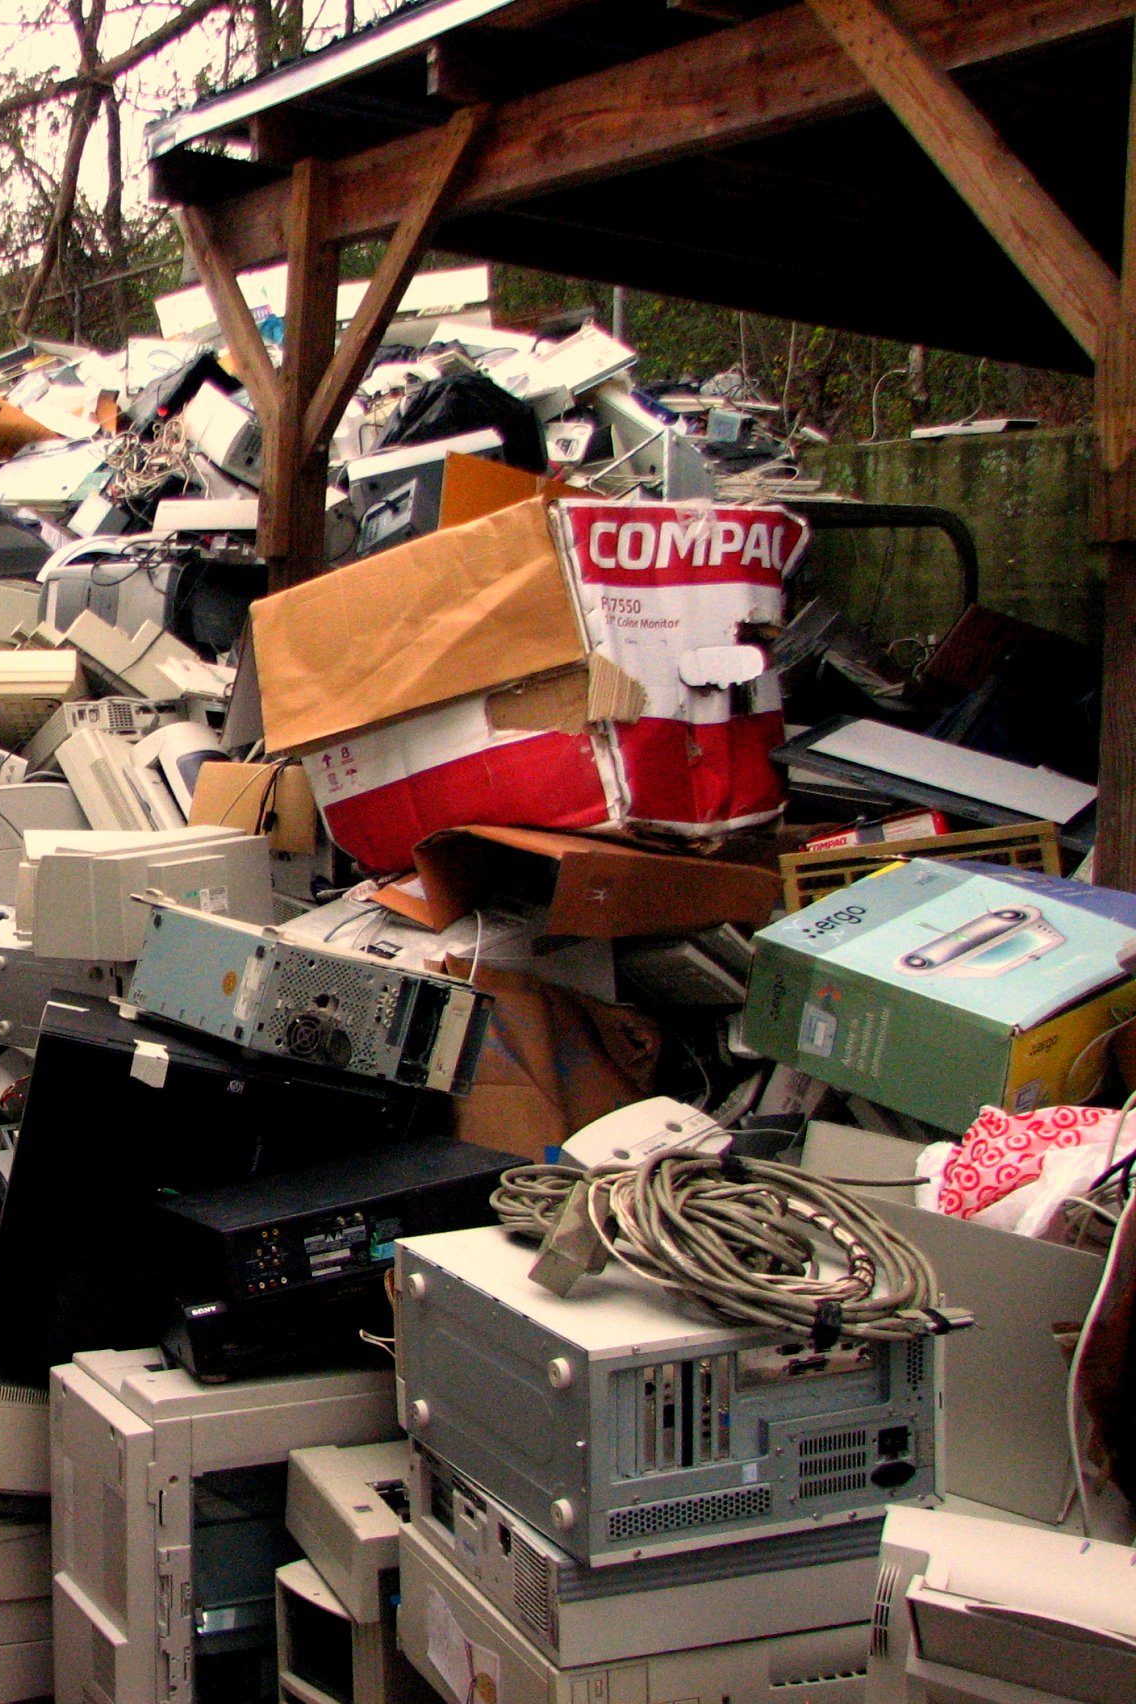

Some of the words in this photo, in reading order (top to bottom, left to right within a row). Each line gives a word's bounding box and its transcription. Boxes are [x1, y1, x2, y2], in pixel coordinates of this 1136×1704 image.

[617, 617, 638, 628] Color
[640, 618, 679, 629] Monitor
[815, 905, 866, 931] ergo
[191, 1305, 217, 1316] SONY
